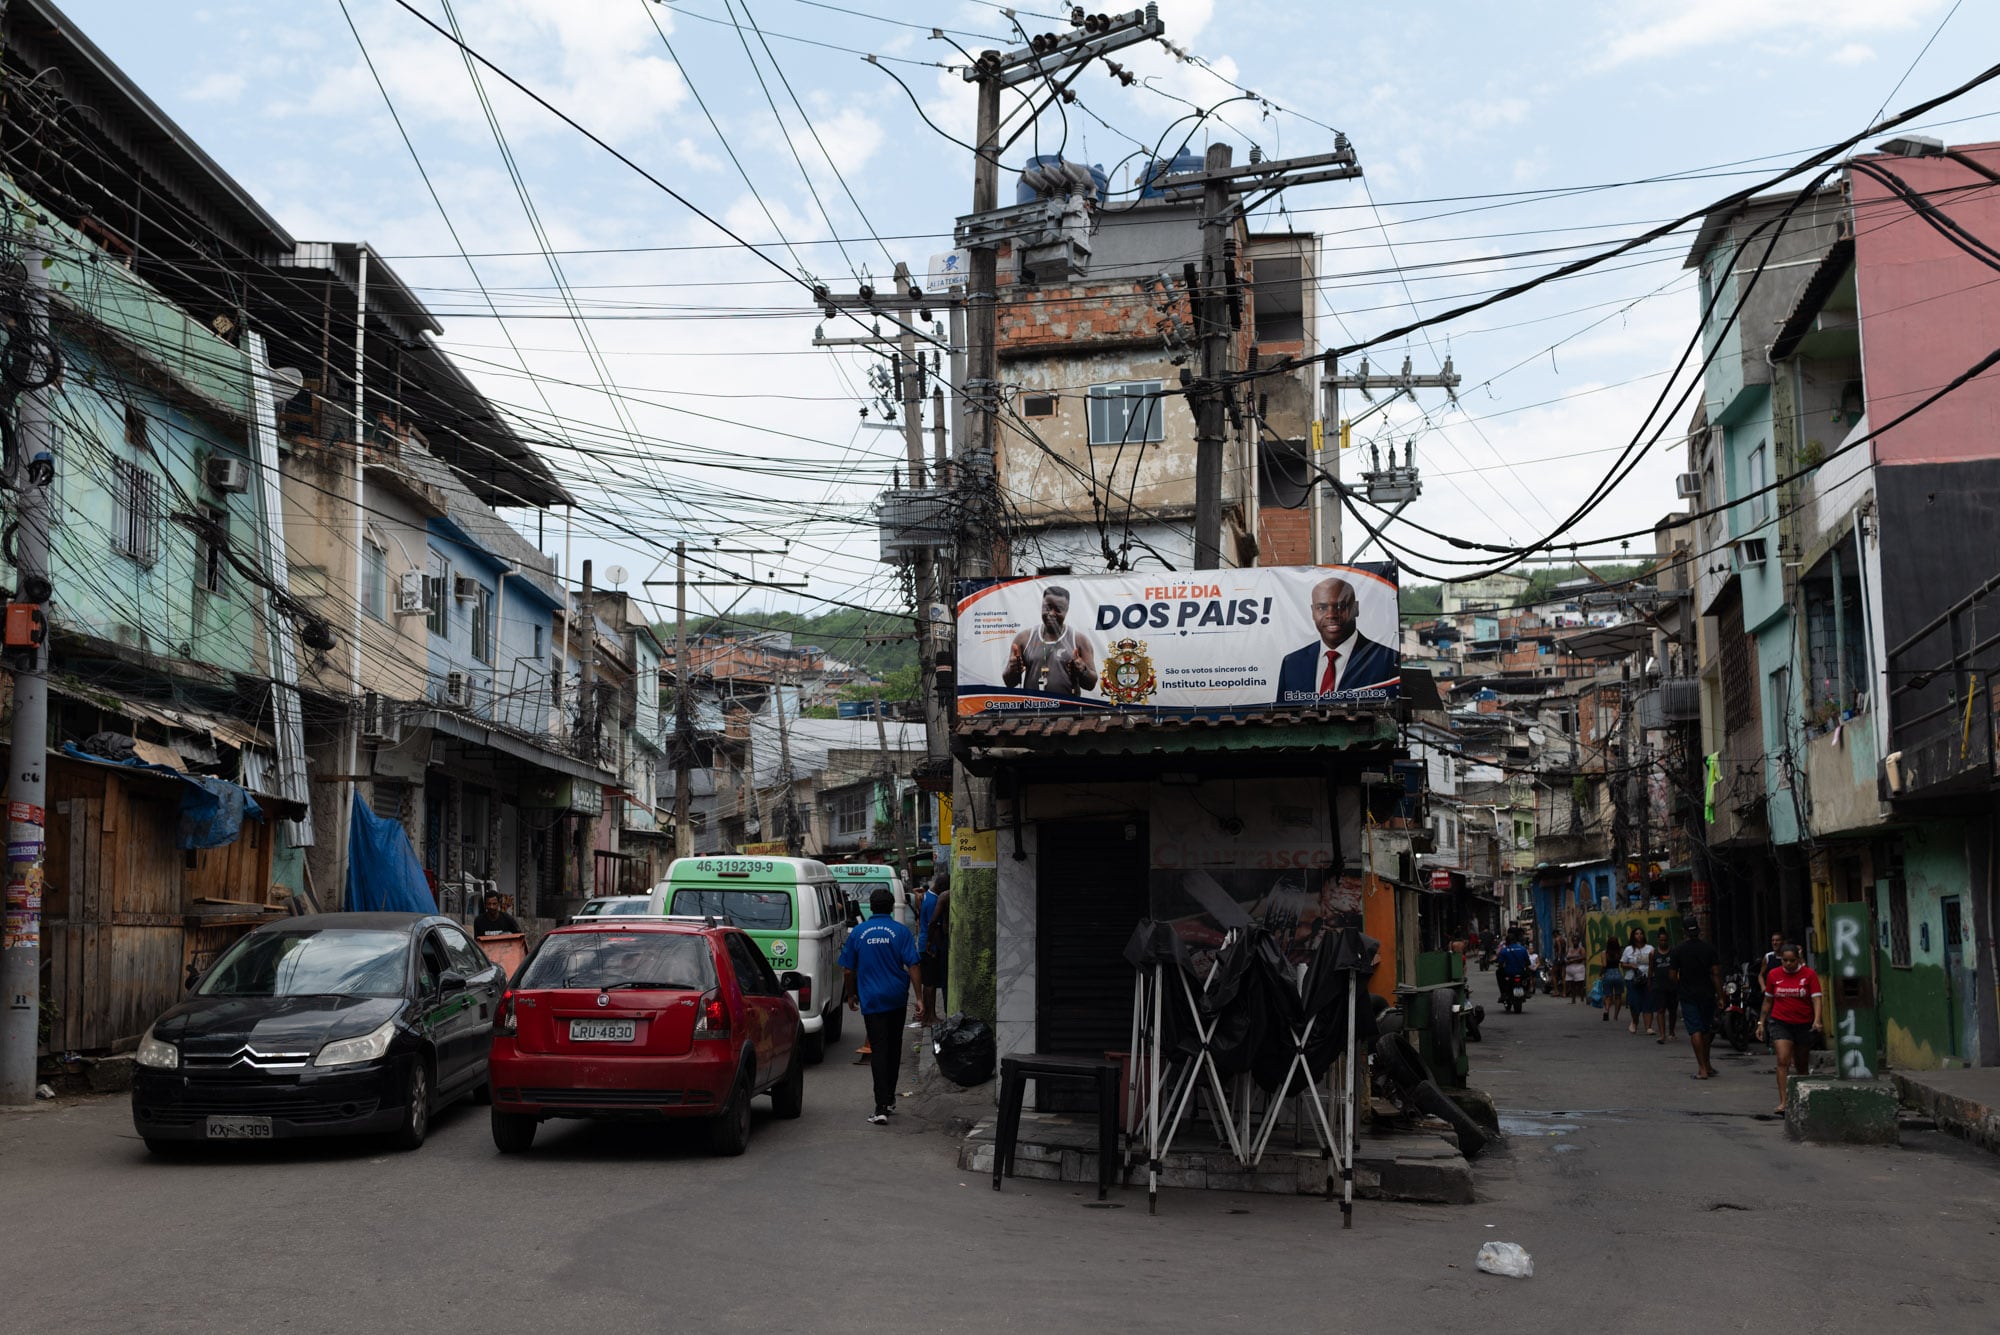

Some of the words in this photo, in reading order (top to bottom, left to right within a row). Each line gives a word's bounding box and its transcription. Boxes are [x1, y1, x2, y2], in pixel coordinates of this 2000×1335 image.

[1145, 586, 1188, 600] FELIZ
[1191, 584, 1222, 599] DIA
[1095, 602, 1170, 630] DOS
[1177, 597, 1273, 628] PAIS!
[1214, 665, 1247, 673] sinceros
[1162, 679, 1206, 689] Instituto
[1209, 677, 1267, 689] Leopoldina
[1284, 690, 1321, 701] Edson
[1323, 689, 1344, 699] dos
[1346, 688, 1387, 699] Santos
[984, 701, 1022, 710] Osmar
[1023, 699, 1060, 709] Nunes
[696, 860, 774, 873] 46.319239-9
[866, 937, 890, 945] CEFAN
